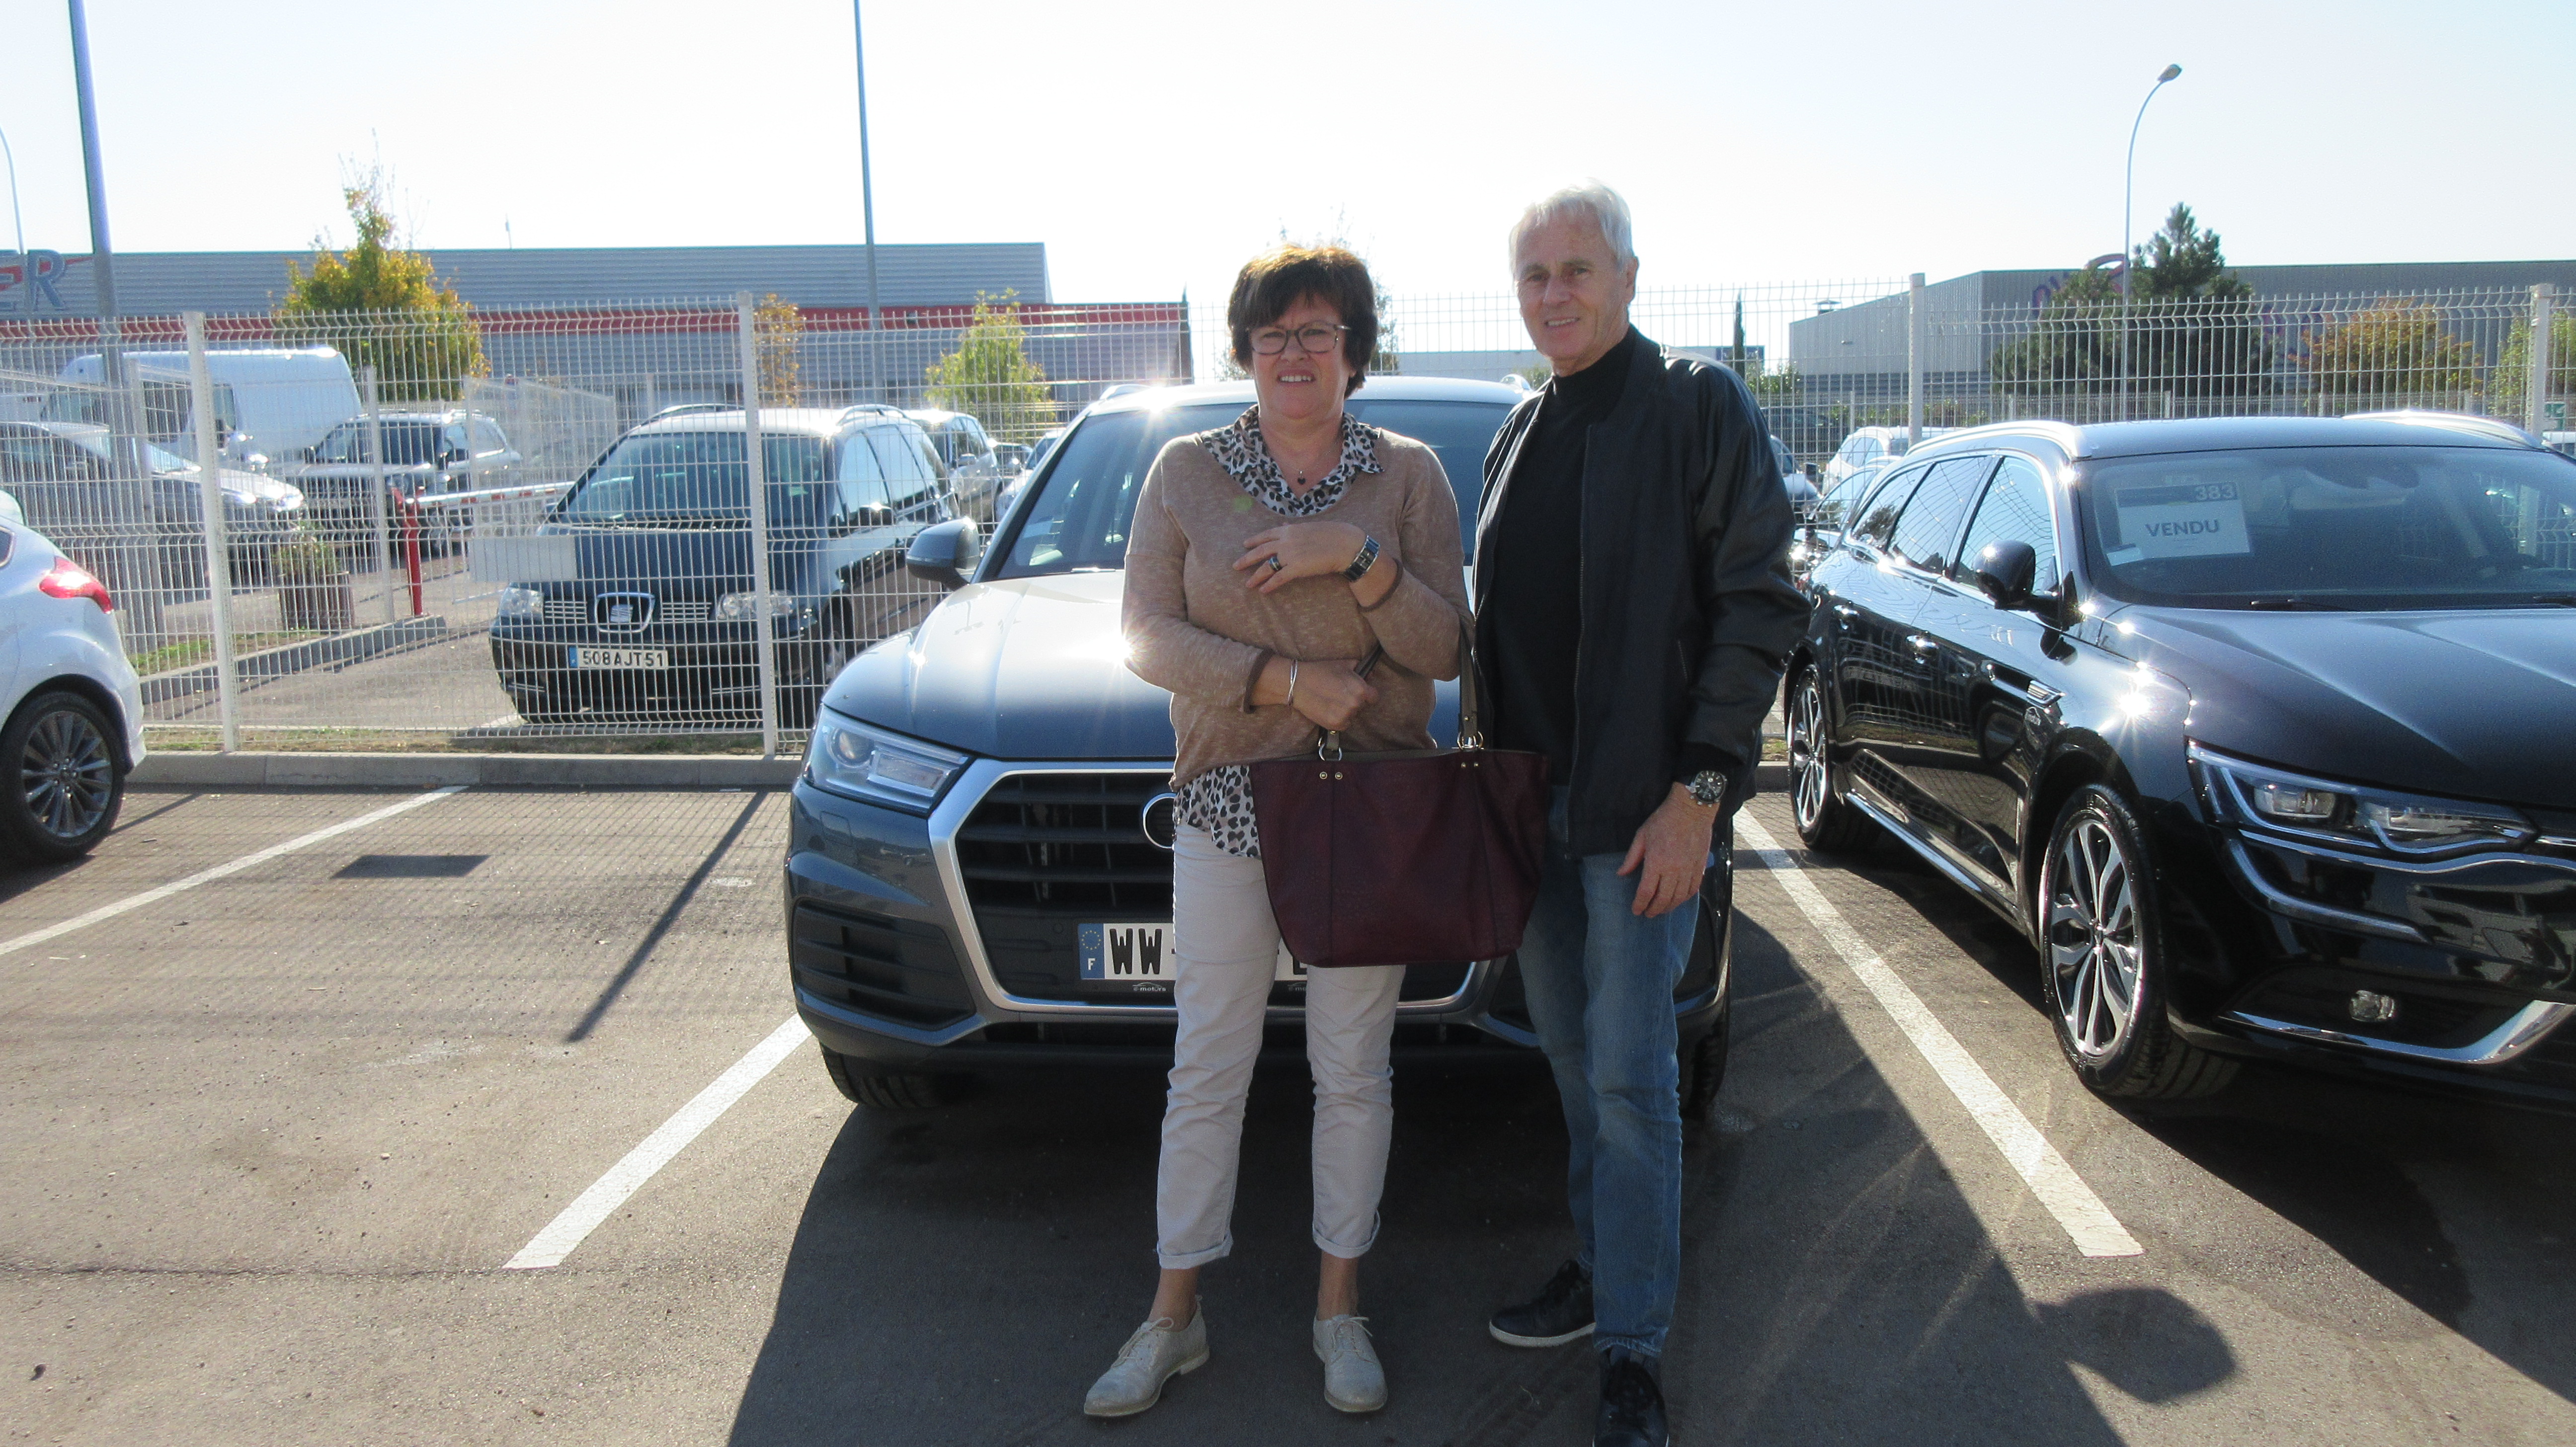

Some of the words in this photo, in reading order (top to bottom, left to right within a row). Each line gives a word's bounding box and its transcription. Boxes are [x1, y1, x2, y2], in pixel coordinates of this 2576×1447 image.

[2194, 484, 2235, 500] 383
[2144, 519, 2219, 537] VENDU
[1088, 958, 1096, 970] F
